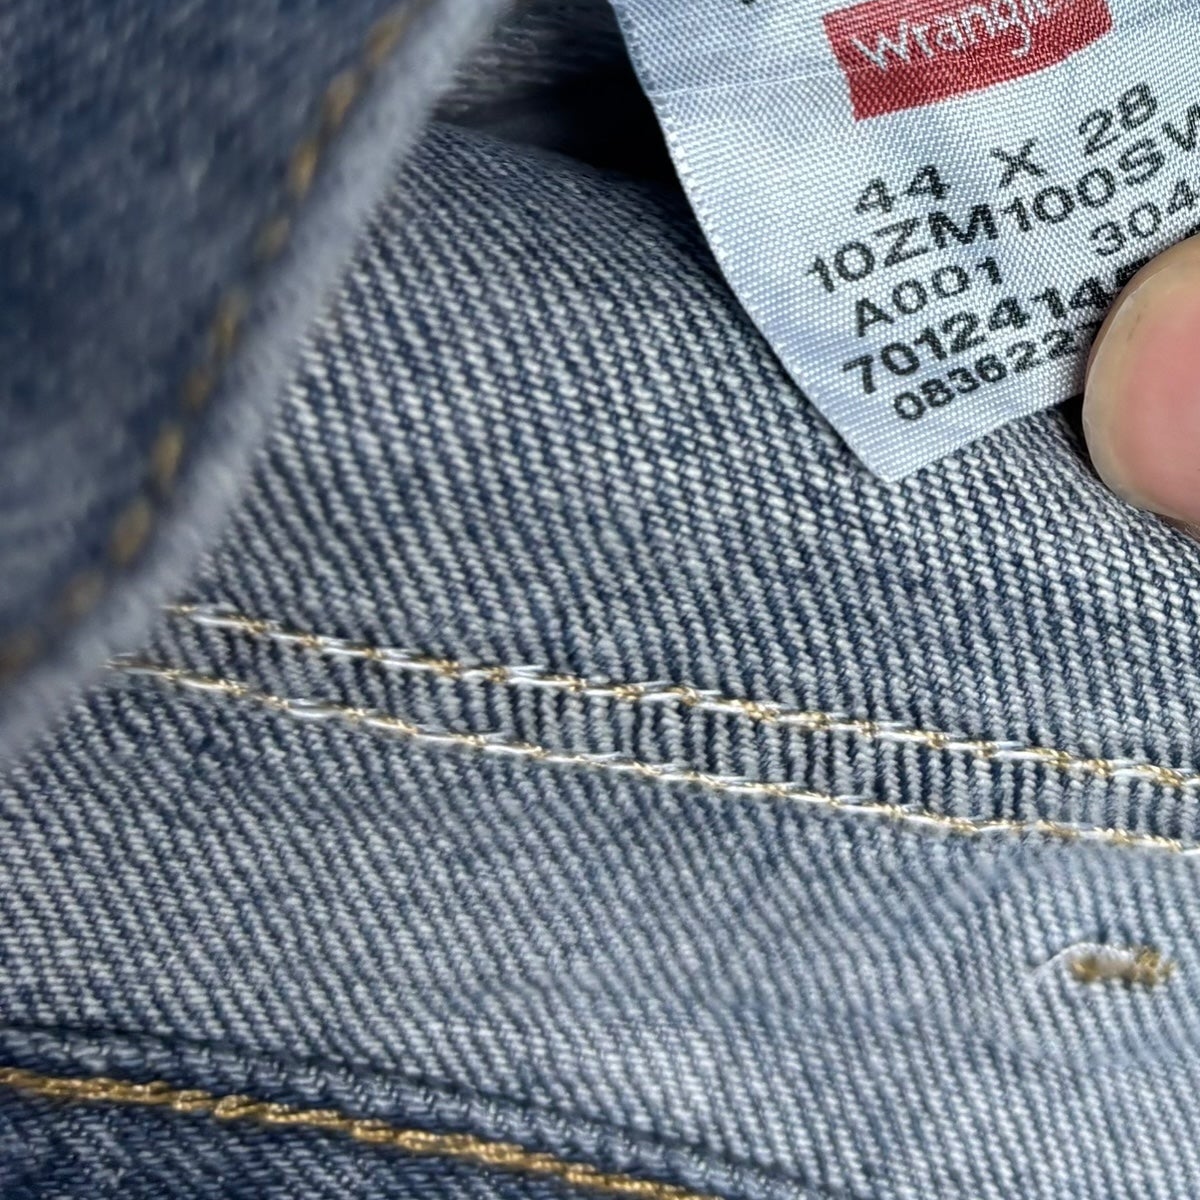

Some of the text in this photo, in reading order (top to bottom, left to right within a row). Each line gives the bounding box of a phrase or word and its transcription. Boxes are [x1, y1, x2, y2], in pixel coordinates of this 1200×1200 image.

[853, 164, 951, 216] 44
[1079, 81, 1158, 156] 28
[854, 256, 1002, 338] A001
